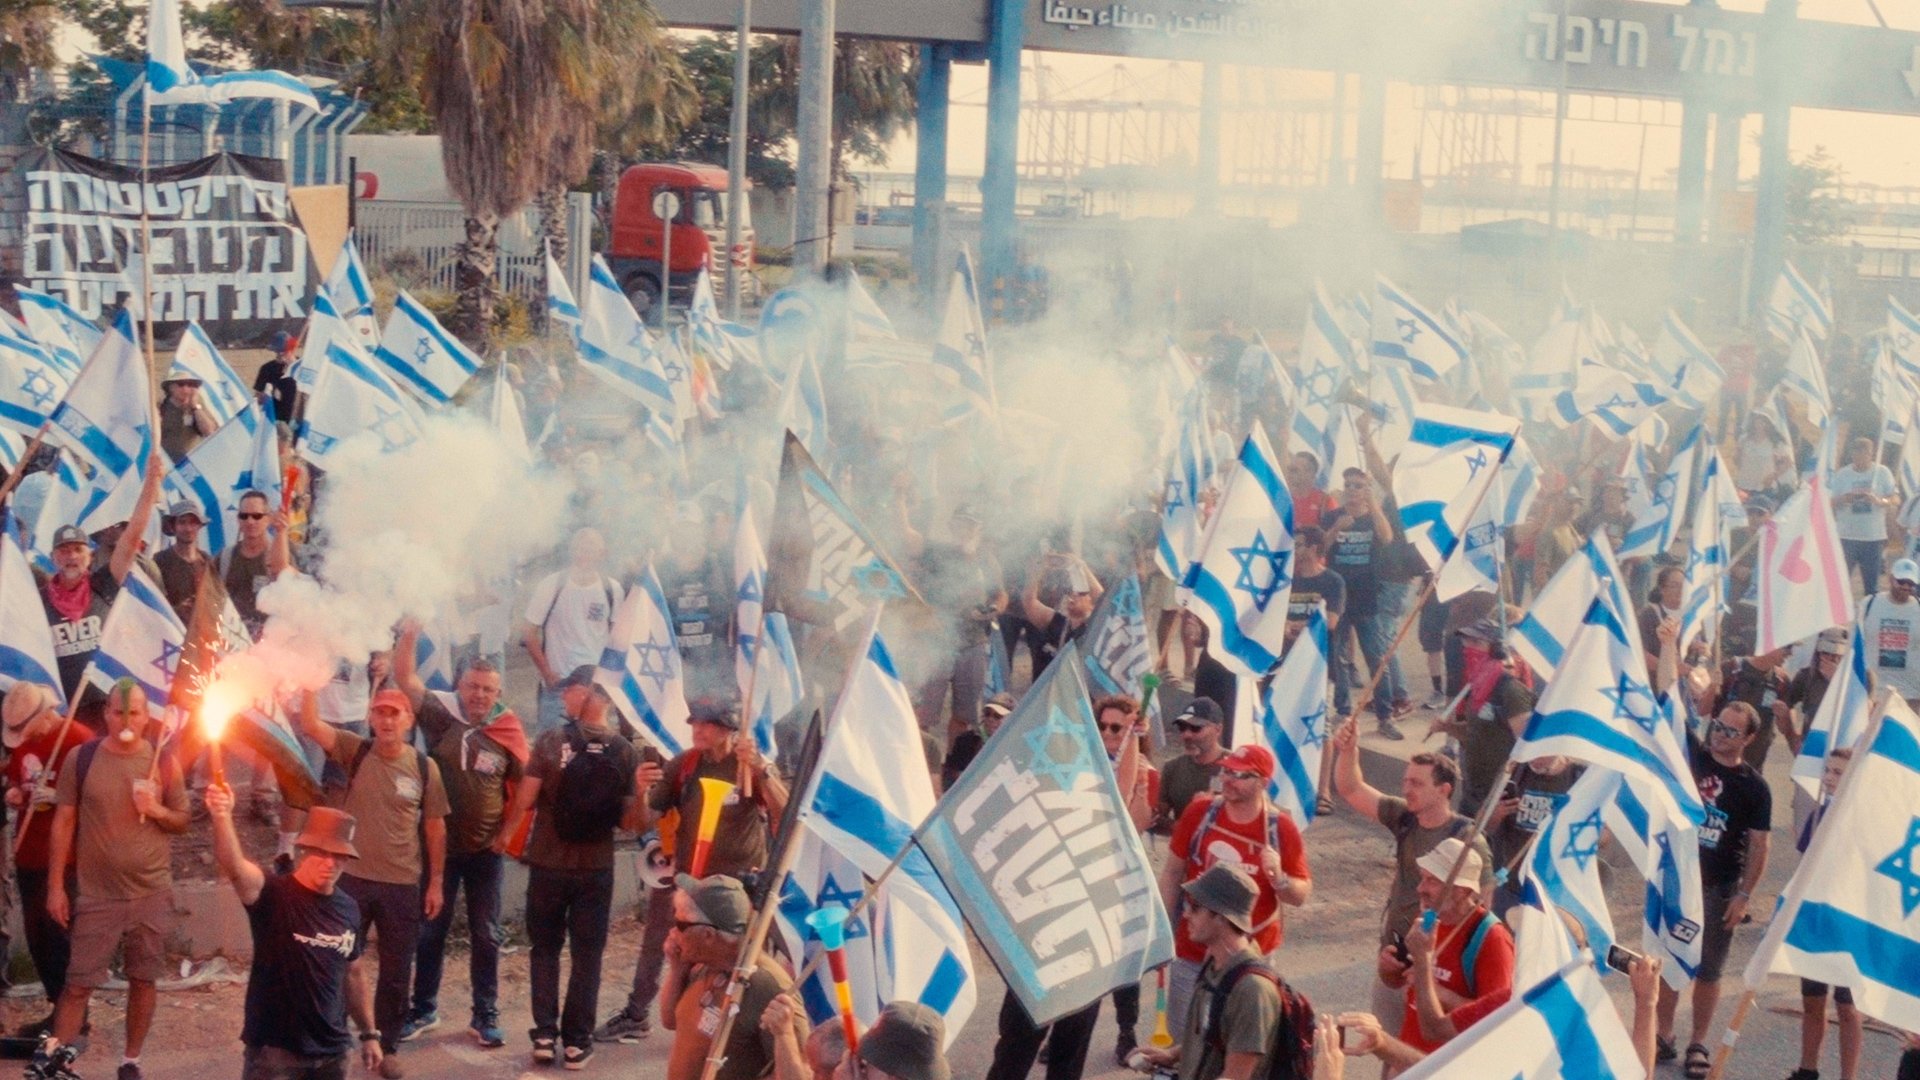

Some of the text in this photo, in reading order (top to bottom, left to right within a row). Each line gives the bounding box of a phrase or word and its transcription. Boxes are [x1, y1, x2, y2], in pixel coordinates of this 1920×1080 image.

[1043, 0, 1094, 30] حيفا
[1098, 7, 1157, 32] ميناء
[1525, 12, 1757, 76] נמל חיפה
[232, 279, 307, 319] את
[50, 615, 102, 646] EVER
